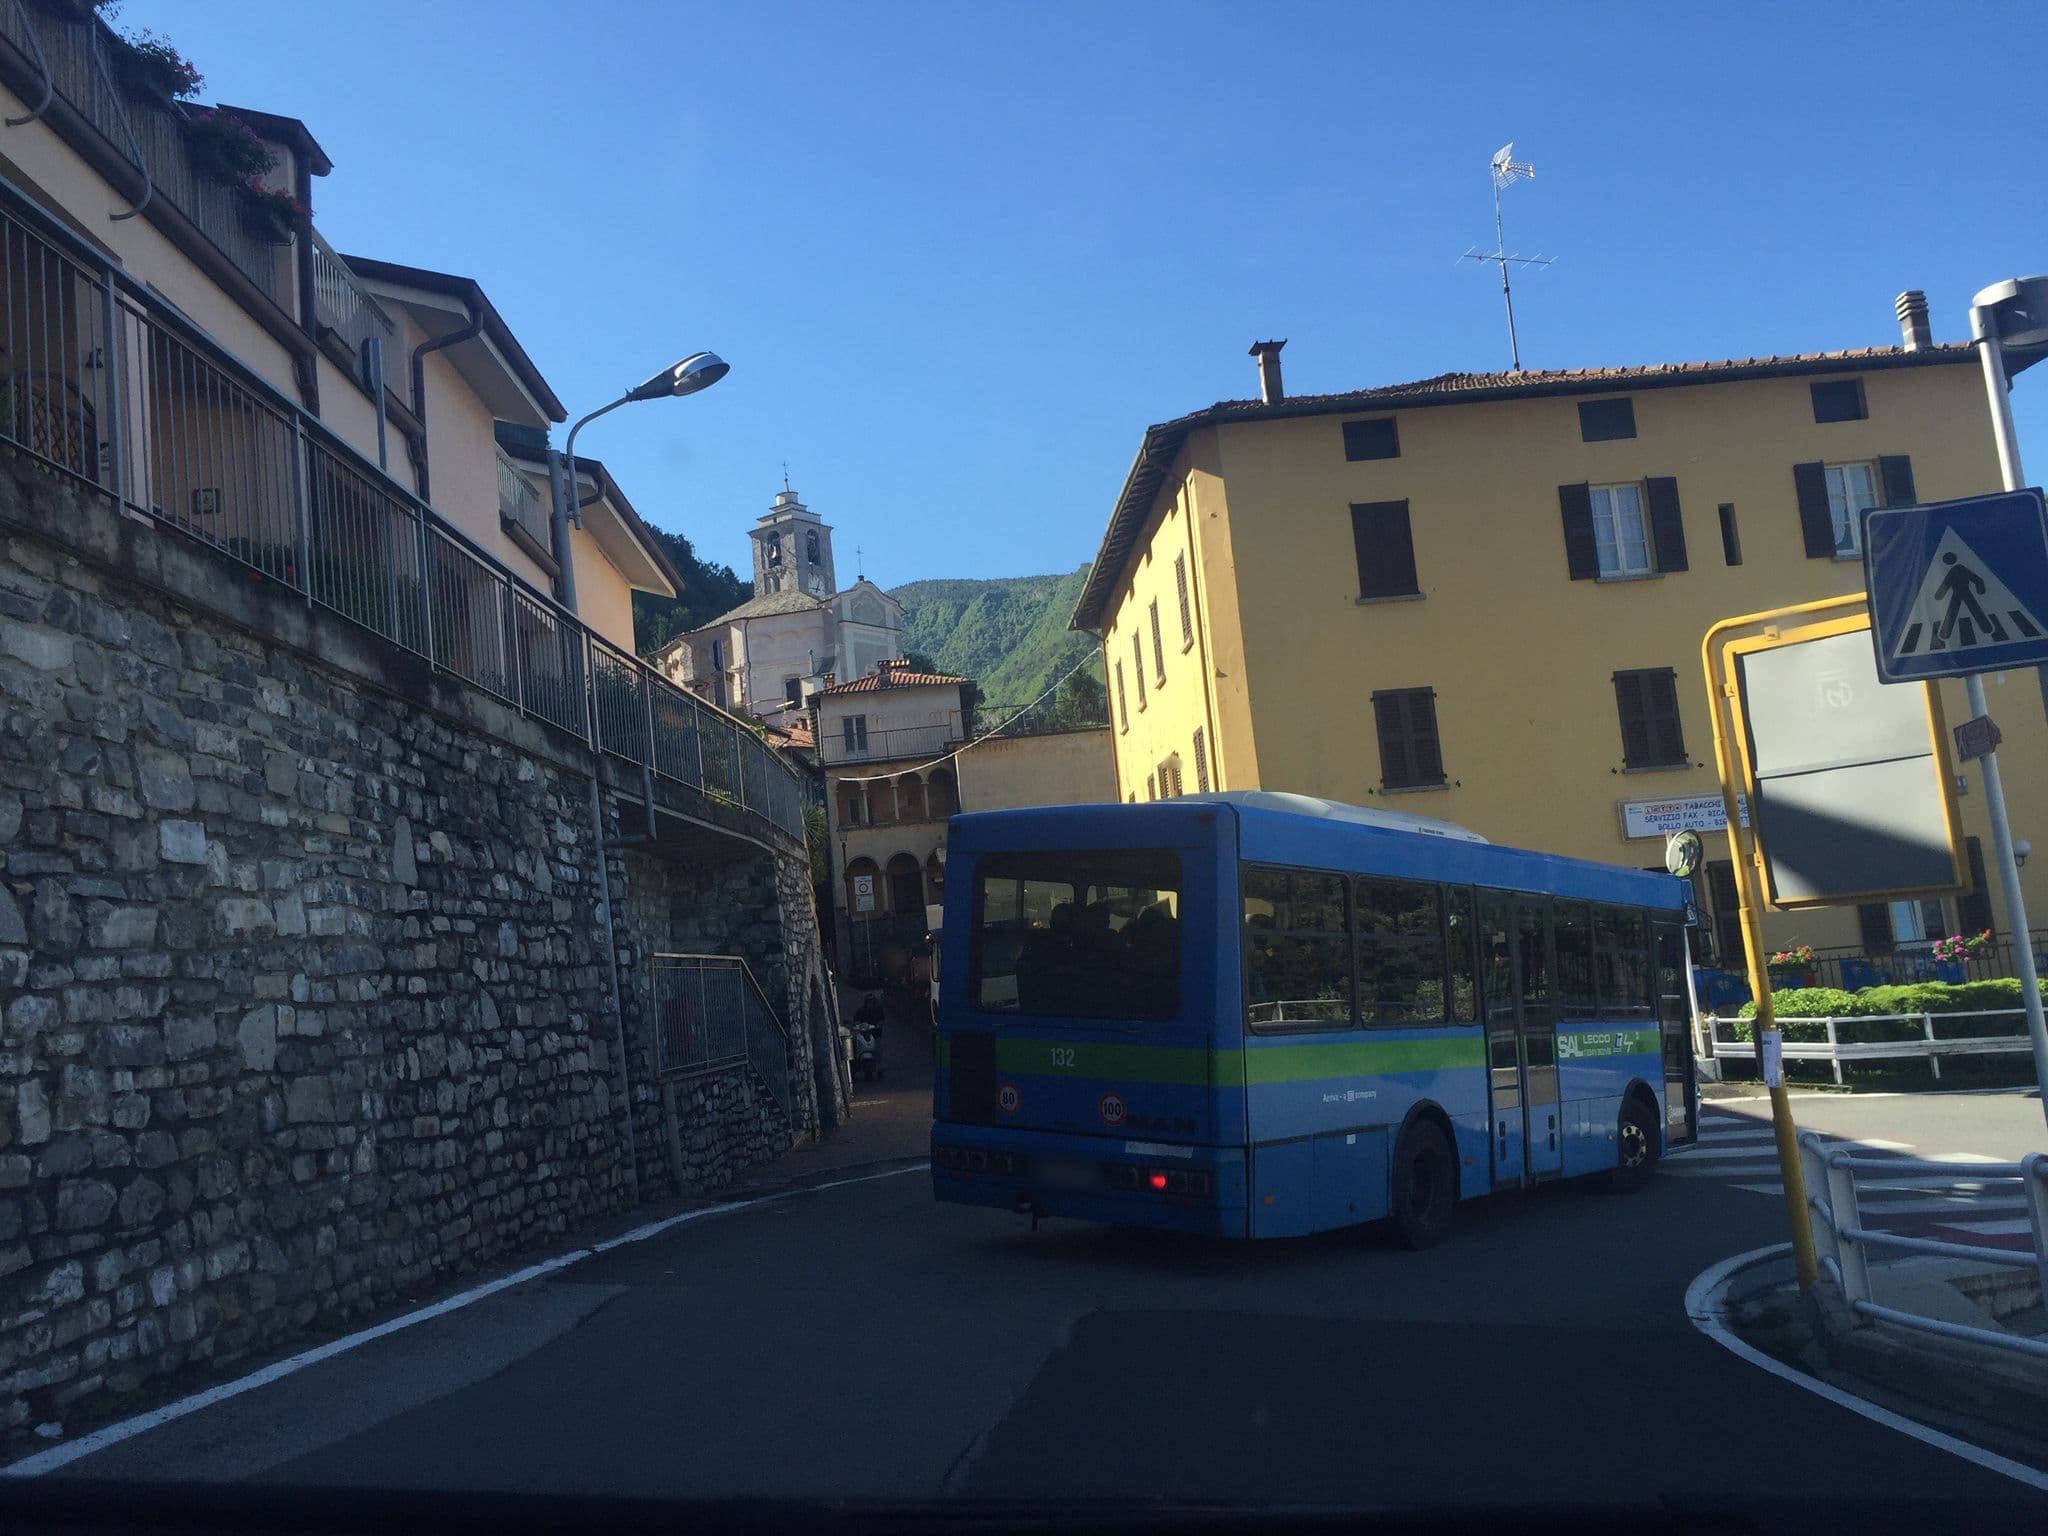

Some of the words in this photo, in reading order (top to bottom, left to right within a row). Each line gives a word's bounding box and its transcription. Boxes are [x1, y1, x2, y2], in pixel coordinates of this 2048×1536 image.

[1684, 800, 1721, 811] TABACCHI
[1645, 812, 1680, 823] SERVIZIO
[1683, 811, 1697, 820] FAX
[1658, 822, 1680, 830] BOLLO
[1684, 820, 1704, 828] AUTO
[1557, 1035, 1583, 1058] SAL
[1583, 1033, 1611, 1044] LECCO
[1050, 1047, 1075, 1067] 132
[1002, 1092, 1015, 1104] 80
[1103, 1102, 1121, 1116] 100
